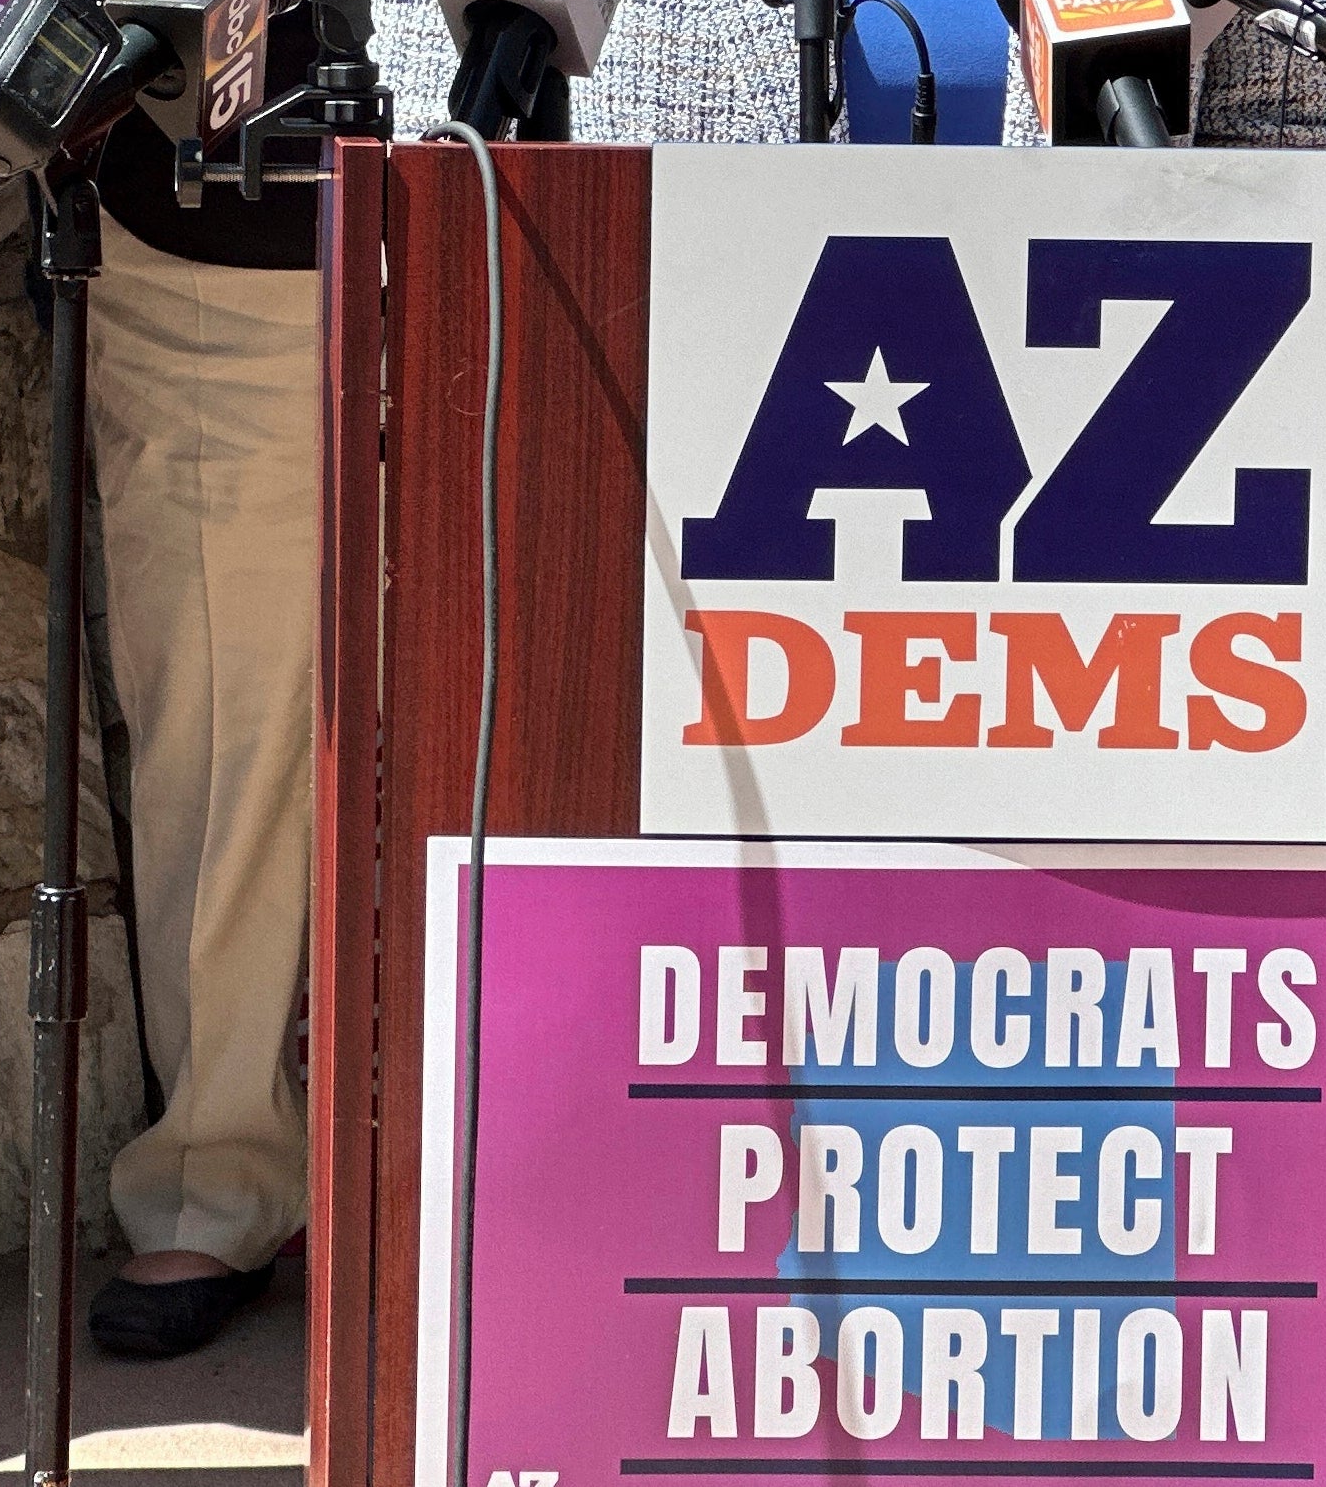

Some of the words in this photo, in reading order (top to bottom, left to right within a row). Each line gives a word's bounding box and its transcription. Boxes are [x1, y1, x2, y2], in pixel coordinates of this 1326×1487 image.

[681, 235, 1313, 585] AZ
[682, 609, 1309, 753] DEMS
[638, 945, 1318, 1070] DEMOCRATS
[718, 1124, 1233, 1256] PROTECT
[667, 1307, 1268, 1442] ABORTION
